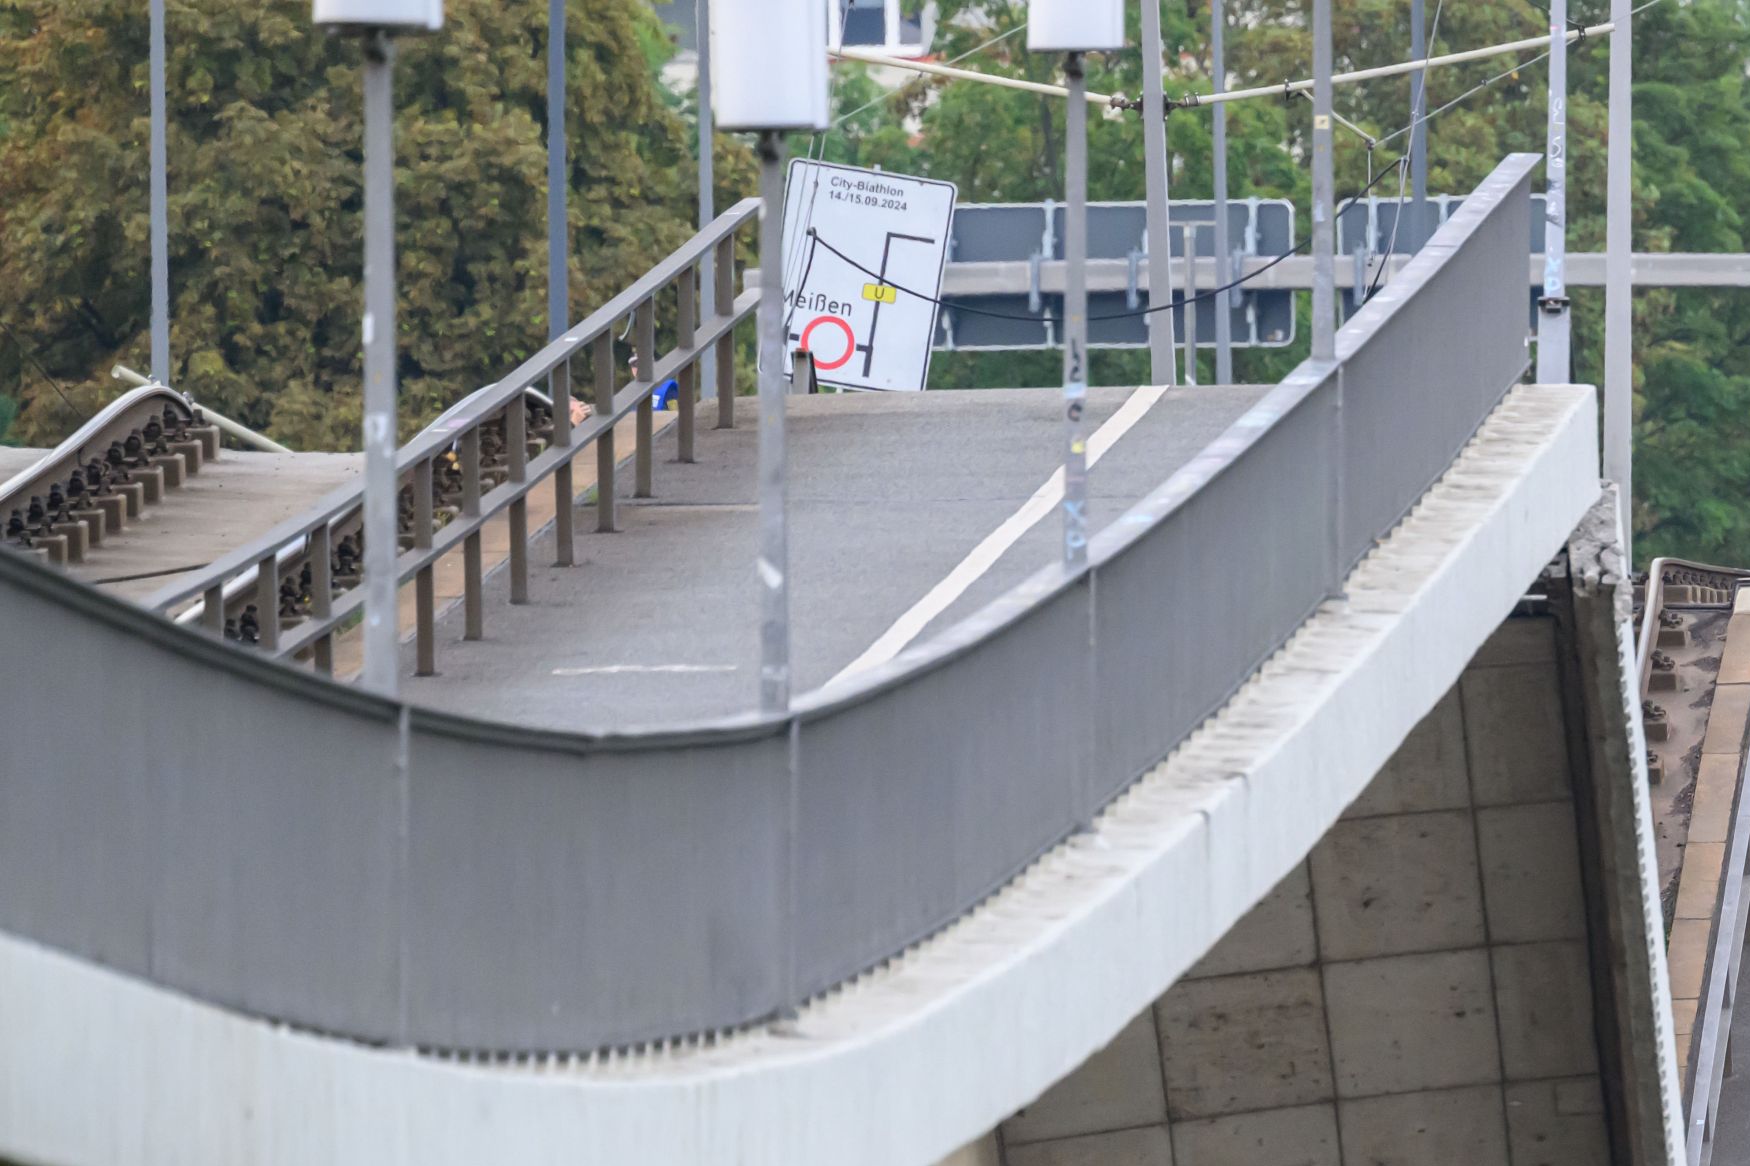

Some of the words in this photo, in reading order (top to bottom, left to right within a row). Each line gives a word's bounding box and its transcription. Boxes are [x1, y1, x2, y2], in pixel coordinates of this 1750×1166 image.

[830, 176, 904, 197] City-Biathlon
[829, 190, 907, 211] 14./15.09.2024
[874, 287, 885, 299] U
